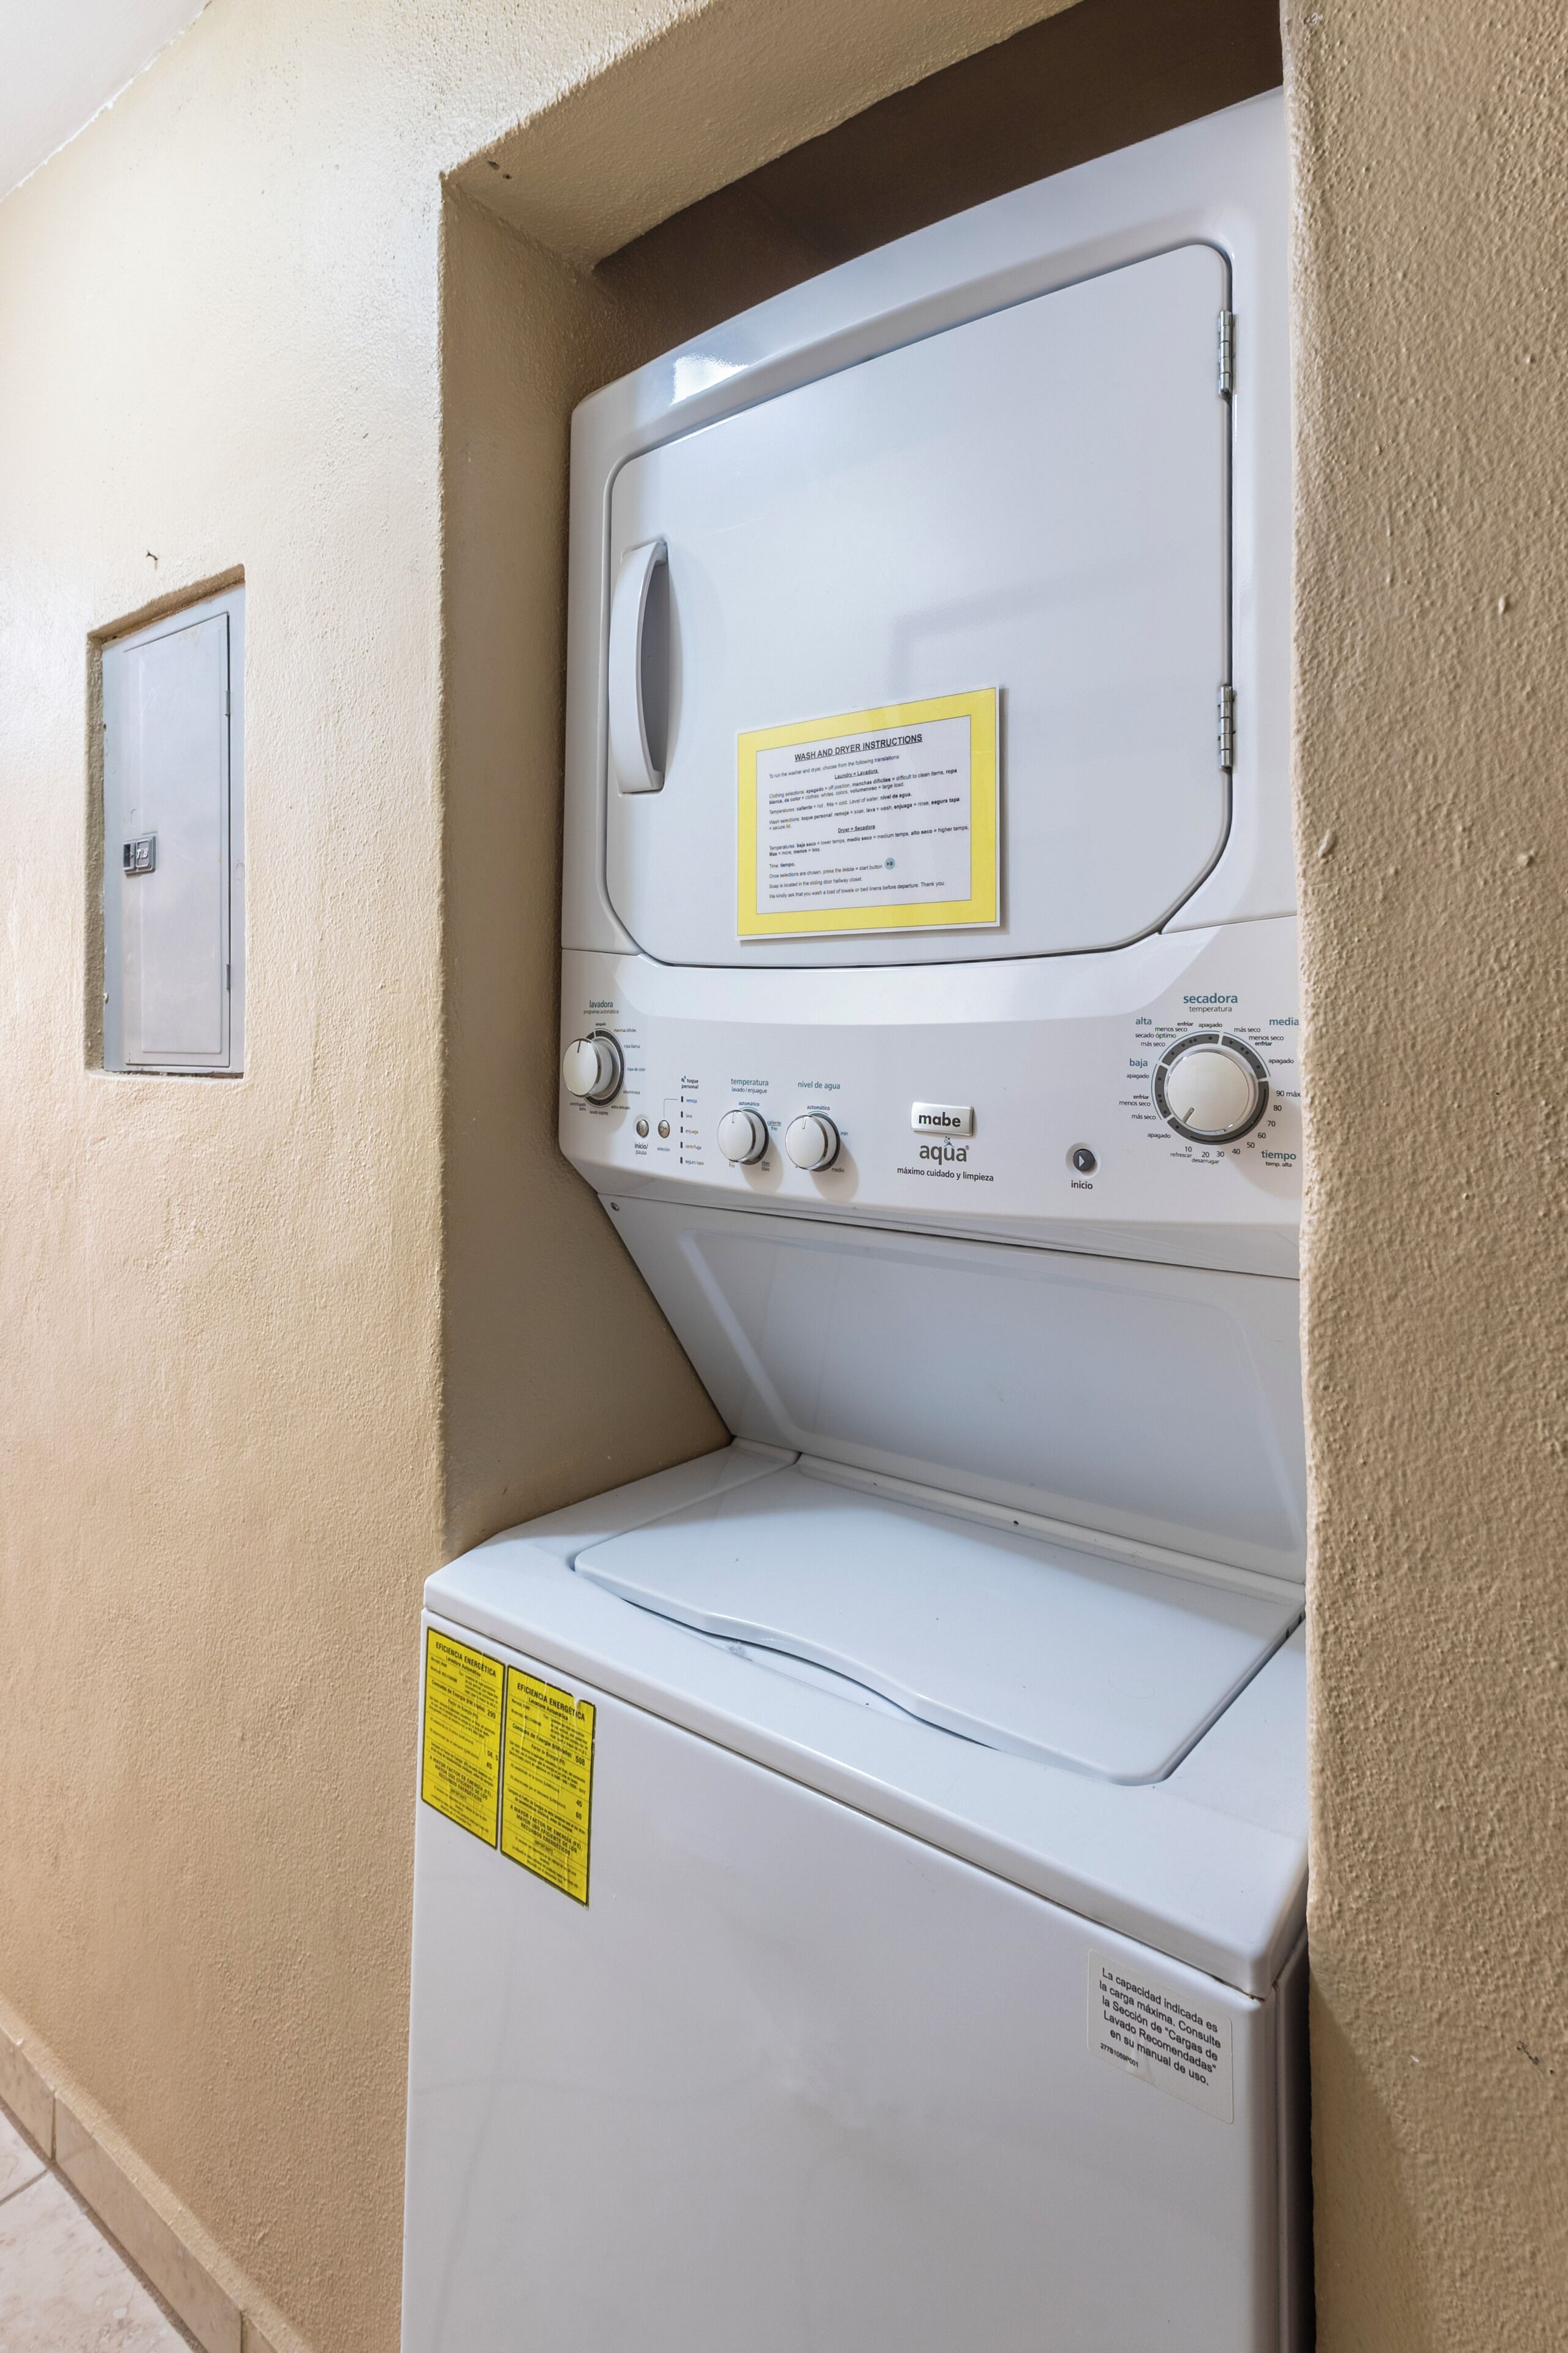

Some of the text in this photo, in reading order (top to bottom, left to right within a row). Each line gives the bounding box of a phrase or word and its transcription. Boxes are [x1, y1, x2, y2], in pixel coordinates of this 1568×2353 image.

[795, 734, 922, 761] WASH AND DRYER INSTRUCTIONS
[1183, 993, 1238, 1004] secadora
[1136, 1017, 1152, 1025] alta
[1269, 1017, 1299, 1026] media
[1129, 1059, 1148, 1067] baja
[918, 1112, 961, 1127] mabe
[1262, 1150, 1296, 1161] tiempo
[897, 1167, 925, 1176] máximo
[926, 1169, 954, 1178] cuidado
[963, 1171, 993, 1181] limpieza
[1071, 1180, 1093, 1189] inicio
[436, 1642, 462, 1661] EFICIENCIA
[464, 1655, 496, 1677] ENERGÉTICA
[517, 1683, 547, 1702] EFICIENCIA
[1102, 1968, 1218, 2033] La capacidad indicada es
[1099, 1980, 1221, 2048] la carga máxima. Consulte
[1104, 2010, 1136, 2034] Lavado
[1102, 1995, 1110, 2007] la
[1113, 1999, 1148, 2026] Sección
[1151, 2020, 1162, 2033] de
[1206, 2048, 1218, 2061] de
[1110, 2029, 1209, 2085] en su manual de uso.
